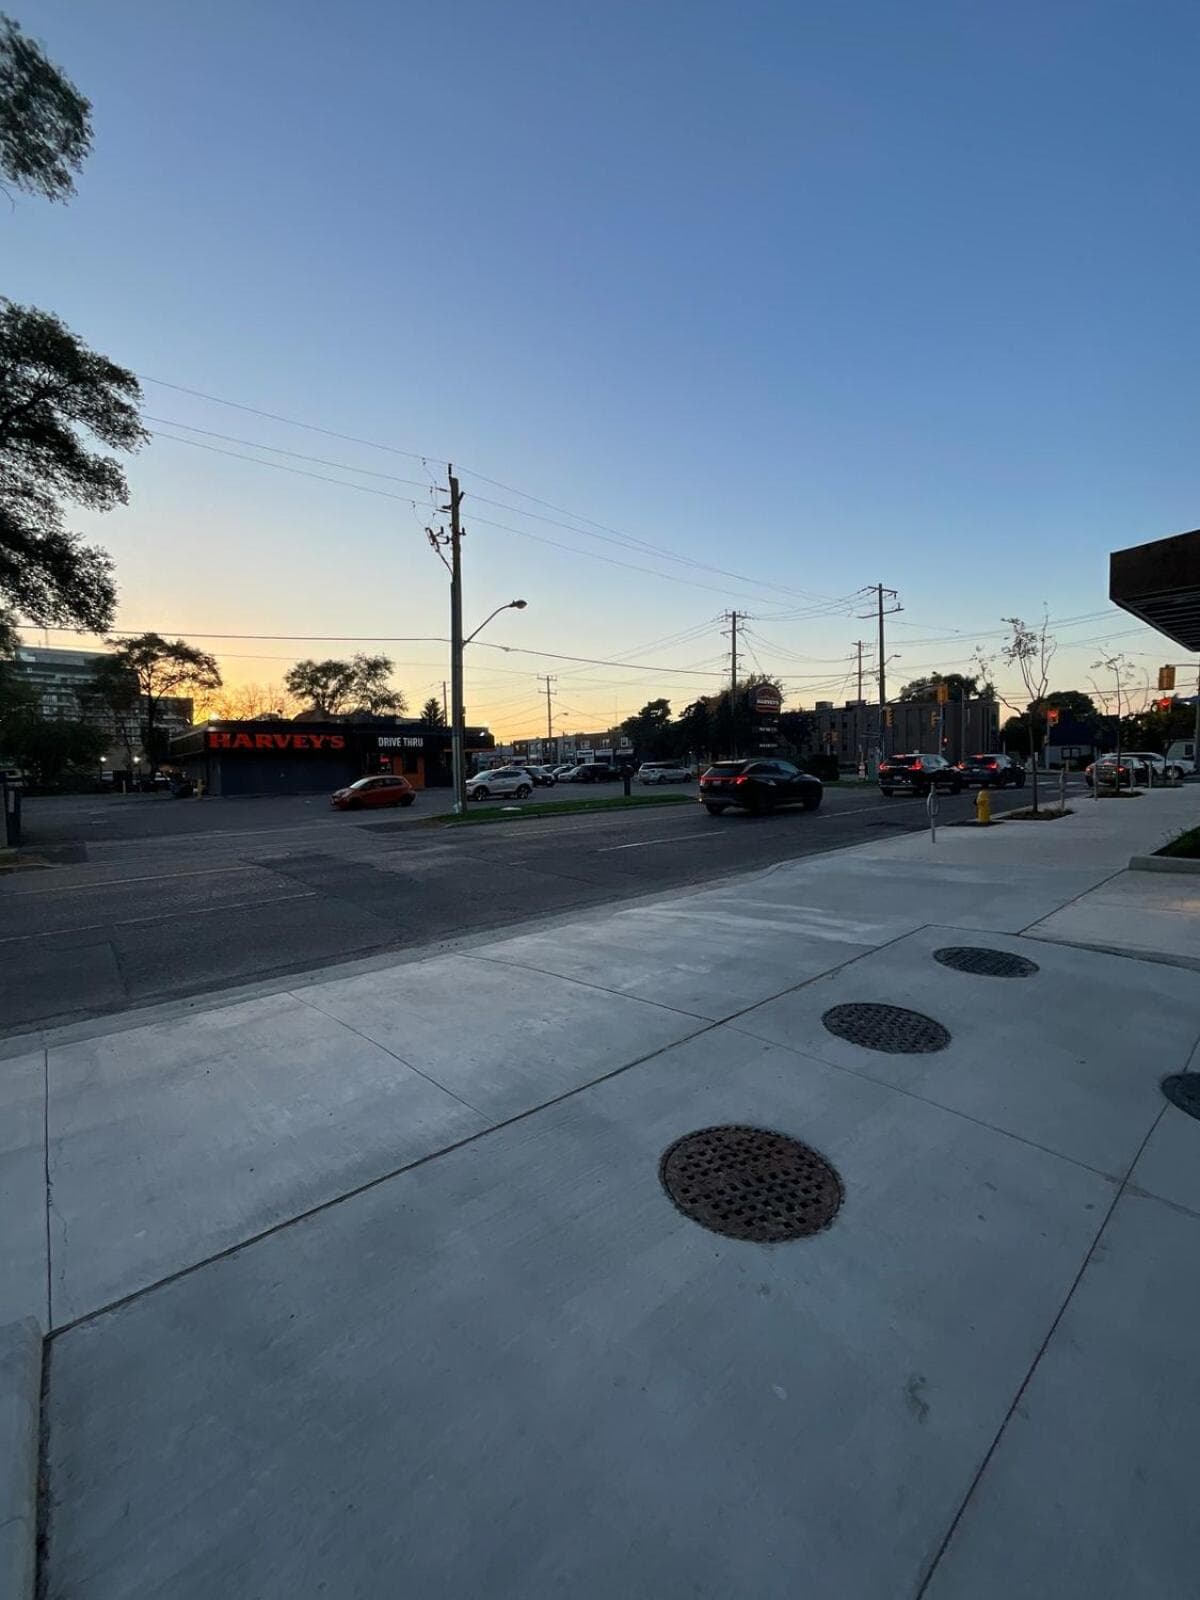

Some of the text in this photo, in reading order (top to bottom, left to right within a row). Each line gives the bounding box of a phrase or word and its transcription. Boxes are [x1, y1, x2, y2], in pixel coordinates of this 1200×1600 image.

[207, 732, 346, 749] HARVEY'S
[377, 736, 424, 747] DRIVE THRU
